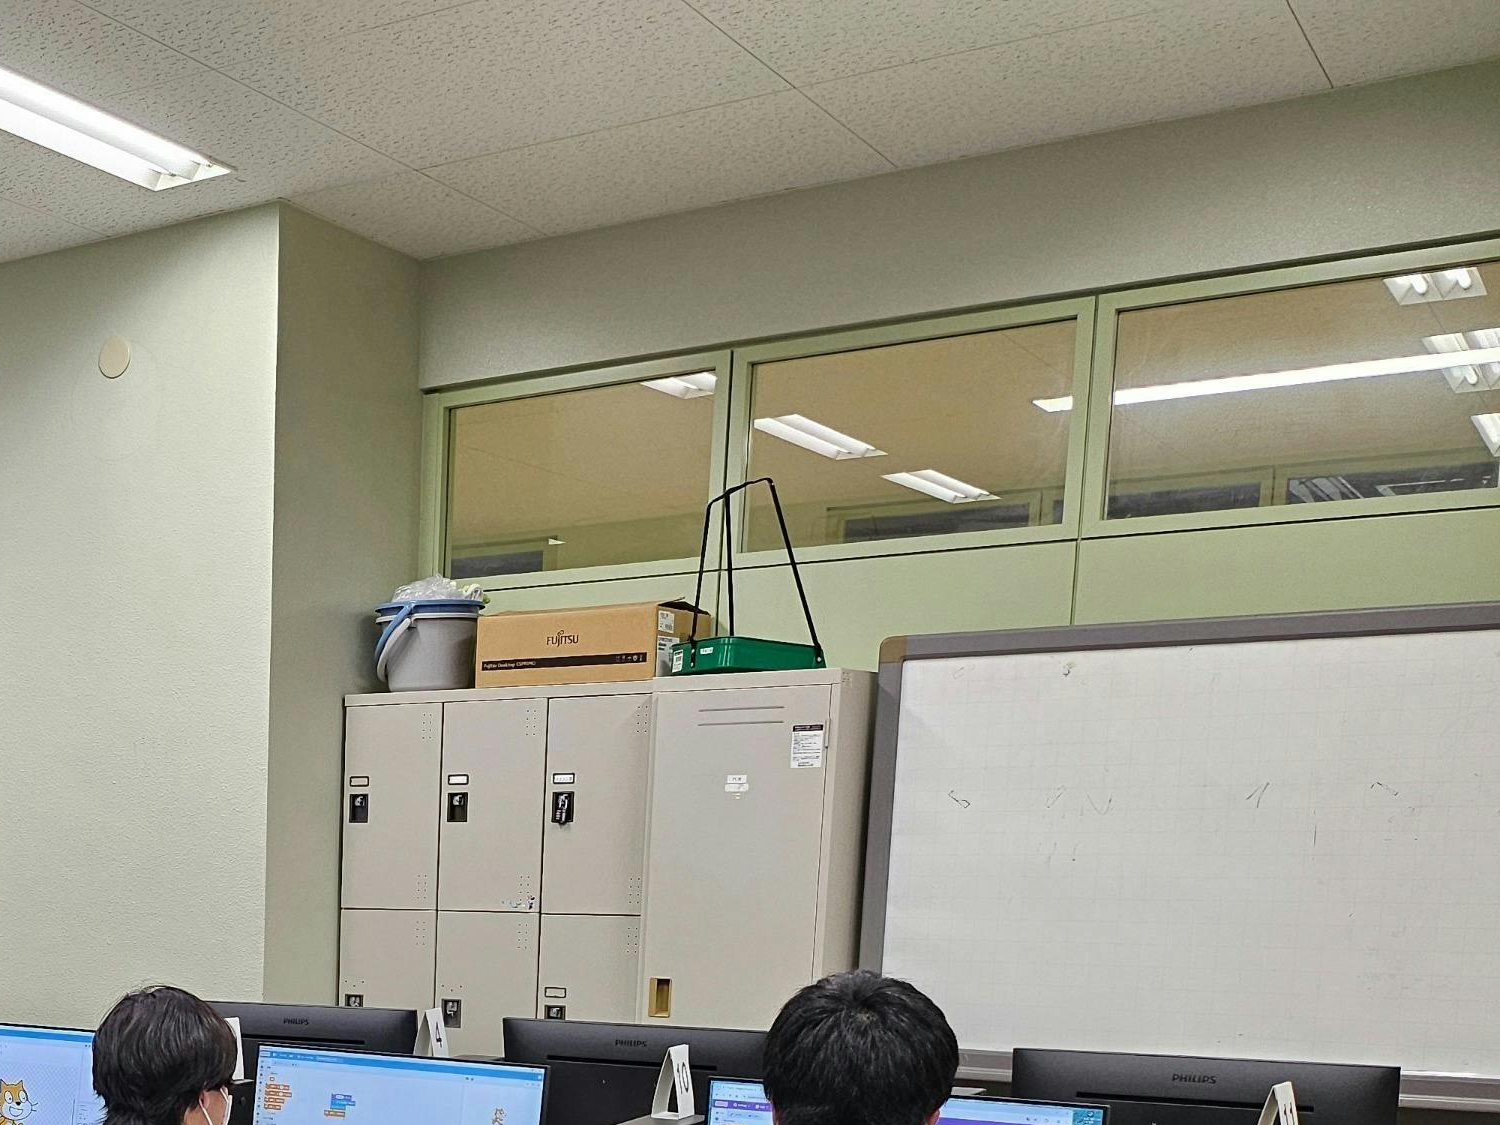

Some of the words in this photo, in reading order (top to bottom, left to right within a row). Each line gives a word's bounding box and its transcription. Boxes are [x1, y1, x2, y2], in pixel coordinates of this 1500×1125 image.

[546, 629, 579, 647] FUJITSU
[283, 1018, 309, 1026] PHILIPS
[435, 1021, 443, 1048] 4
[615, 1039, 648, 1047] PHILIPS
[676, 1061, 689, 1095] 10
[1172, 1074, 1217, 1084] PHILIPS
